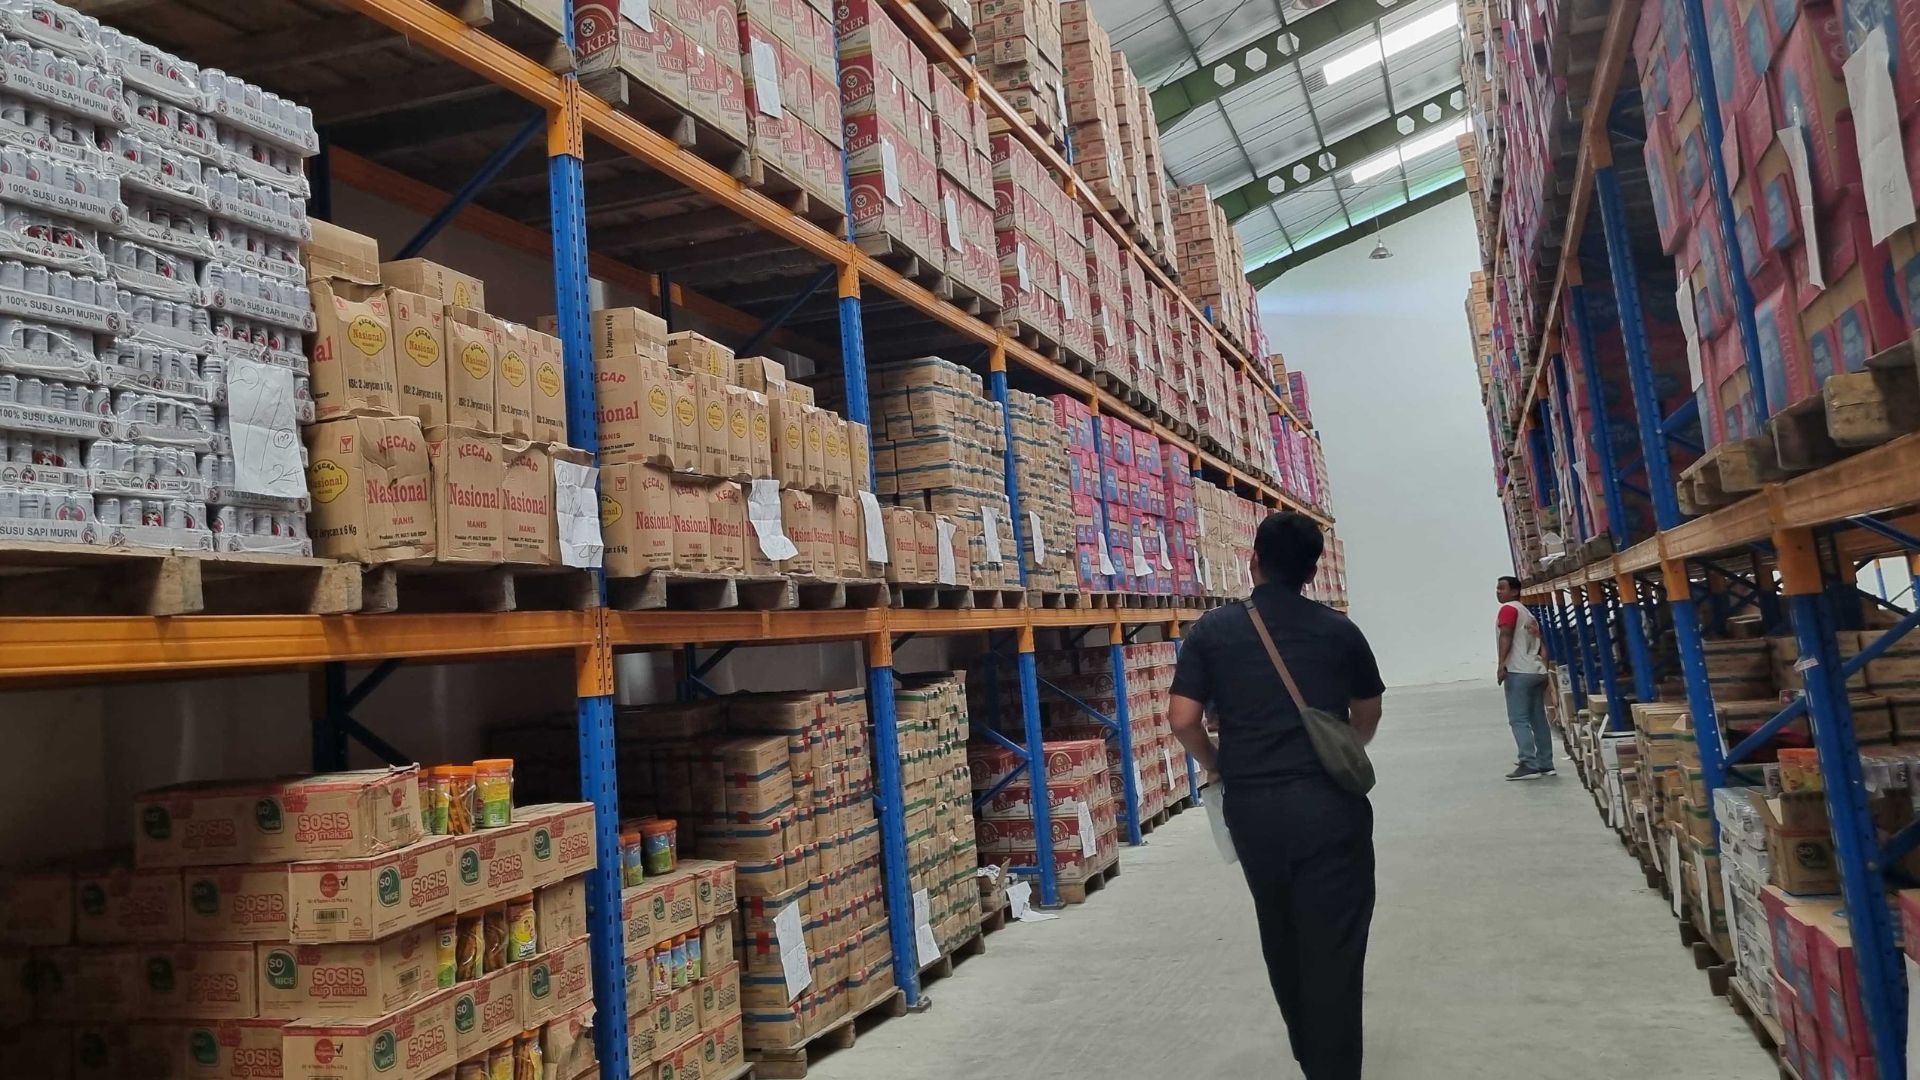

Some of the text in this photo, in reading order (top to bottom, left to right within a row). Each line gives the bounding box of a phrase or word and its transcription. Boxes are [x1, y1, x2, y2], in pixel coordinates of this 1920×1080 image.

[837, 17, 865, 34] NKER
[576, 29, 619, 57] NKER
[622, 31, 651, 50] ANKER
[657, 53, 683, 71] ANKER
[691, 75, 715, 91] ANKER
[13, 73, 35, 87] 100%
[61, 90, 81, 103] SAPI
[82, 98, 109, 112] MURNI
[843, 83, 874, 103] NKER
[8, 183, 31, 196] 100%
[33, 189, 56, 202] SUSU
[58, 196, 78, 208] SAPI
[79, 202, 106, 215] MURNI
[852, 203, 883, 222] NKER
[5, 295, 103, 322] 100% SUSU SAPI MURNI
[247, 301, 265, 313] SUSU
[265, 306, 280, 316] SAPI
[352, 329, 383, 343] Nasional
[409, 340, 435, 355] Nasional
[595, 372, 626, 384] ECAP
[0, 409, 95, 429] 100% SUSU SAPI MURNI
[376, 435, 416, 453] KECAP
[458, 444, 493, 463] KECAP
[309, 475, 342, 490] asional
[367, 479, 428, 504] Nasional
[642, 477, 664, 491] KECAP
[449, 482, 500, 510] Nasional
[676, 486, 700, 498] KECAP
[502, 489, 547, 516] Nasional
[392, 516, 414, 526] MANIS
[467, 520, 487, 529] MANIS
[635, 511, 672, 530] Nasional
[674, 514, 709, 533] Nasional
[0, 527, 78, 538] SUSU SAPI MURNI
[349, 524, 357, 536] Kg
[298, 813, 350, 831] SOSIS
[319, 830, 353, 841] makan
[535, 834, 544, 845] SO
[560, 832, 588, 853] SOSIS
[461, 857, 471, 867] SO
[489, 854, 522, 876] SOSIS
[379, 877, 391, 888] SO
[411, 870, 447, 895] SOSIS
[234, 895, 284, 912] SOSIS
[270, 959, 283, 968] SO
[275, 977, 294, 985] NICE
[313, 968, 365, 986] SOSIS
[332, 986, 367, 997] makan
[457, 1003, 467, 1015] SO
[483, 994, 513, 1021] SOSIS
[375, 1041, 387, 1054] SO
[408, 1025, 446, 1057] SOSIS
[234, 1048, 283, 1067] SOSIS
